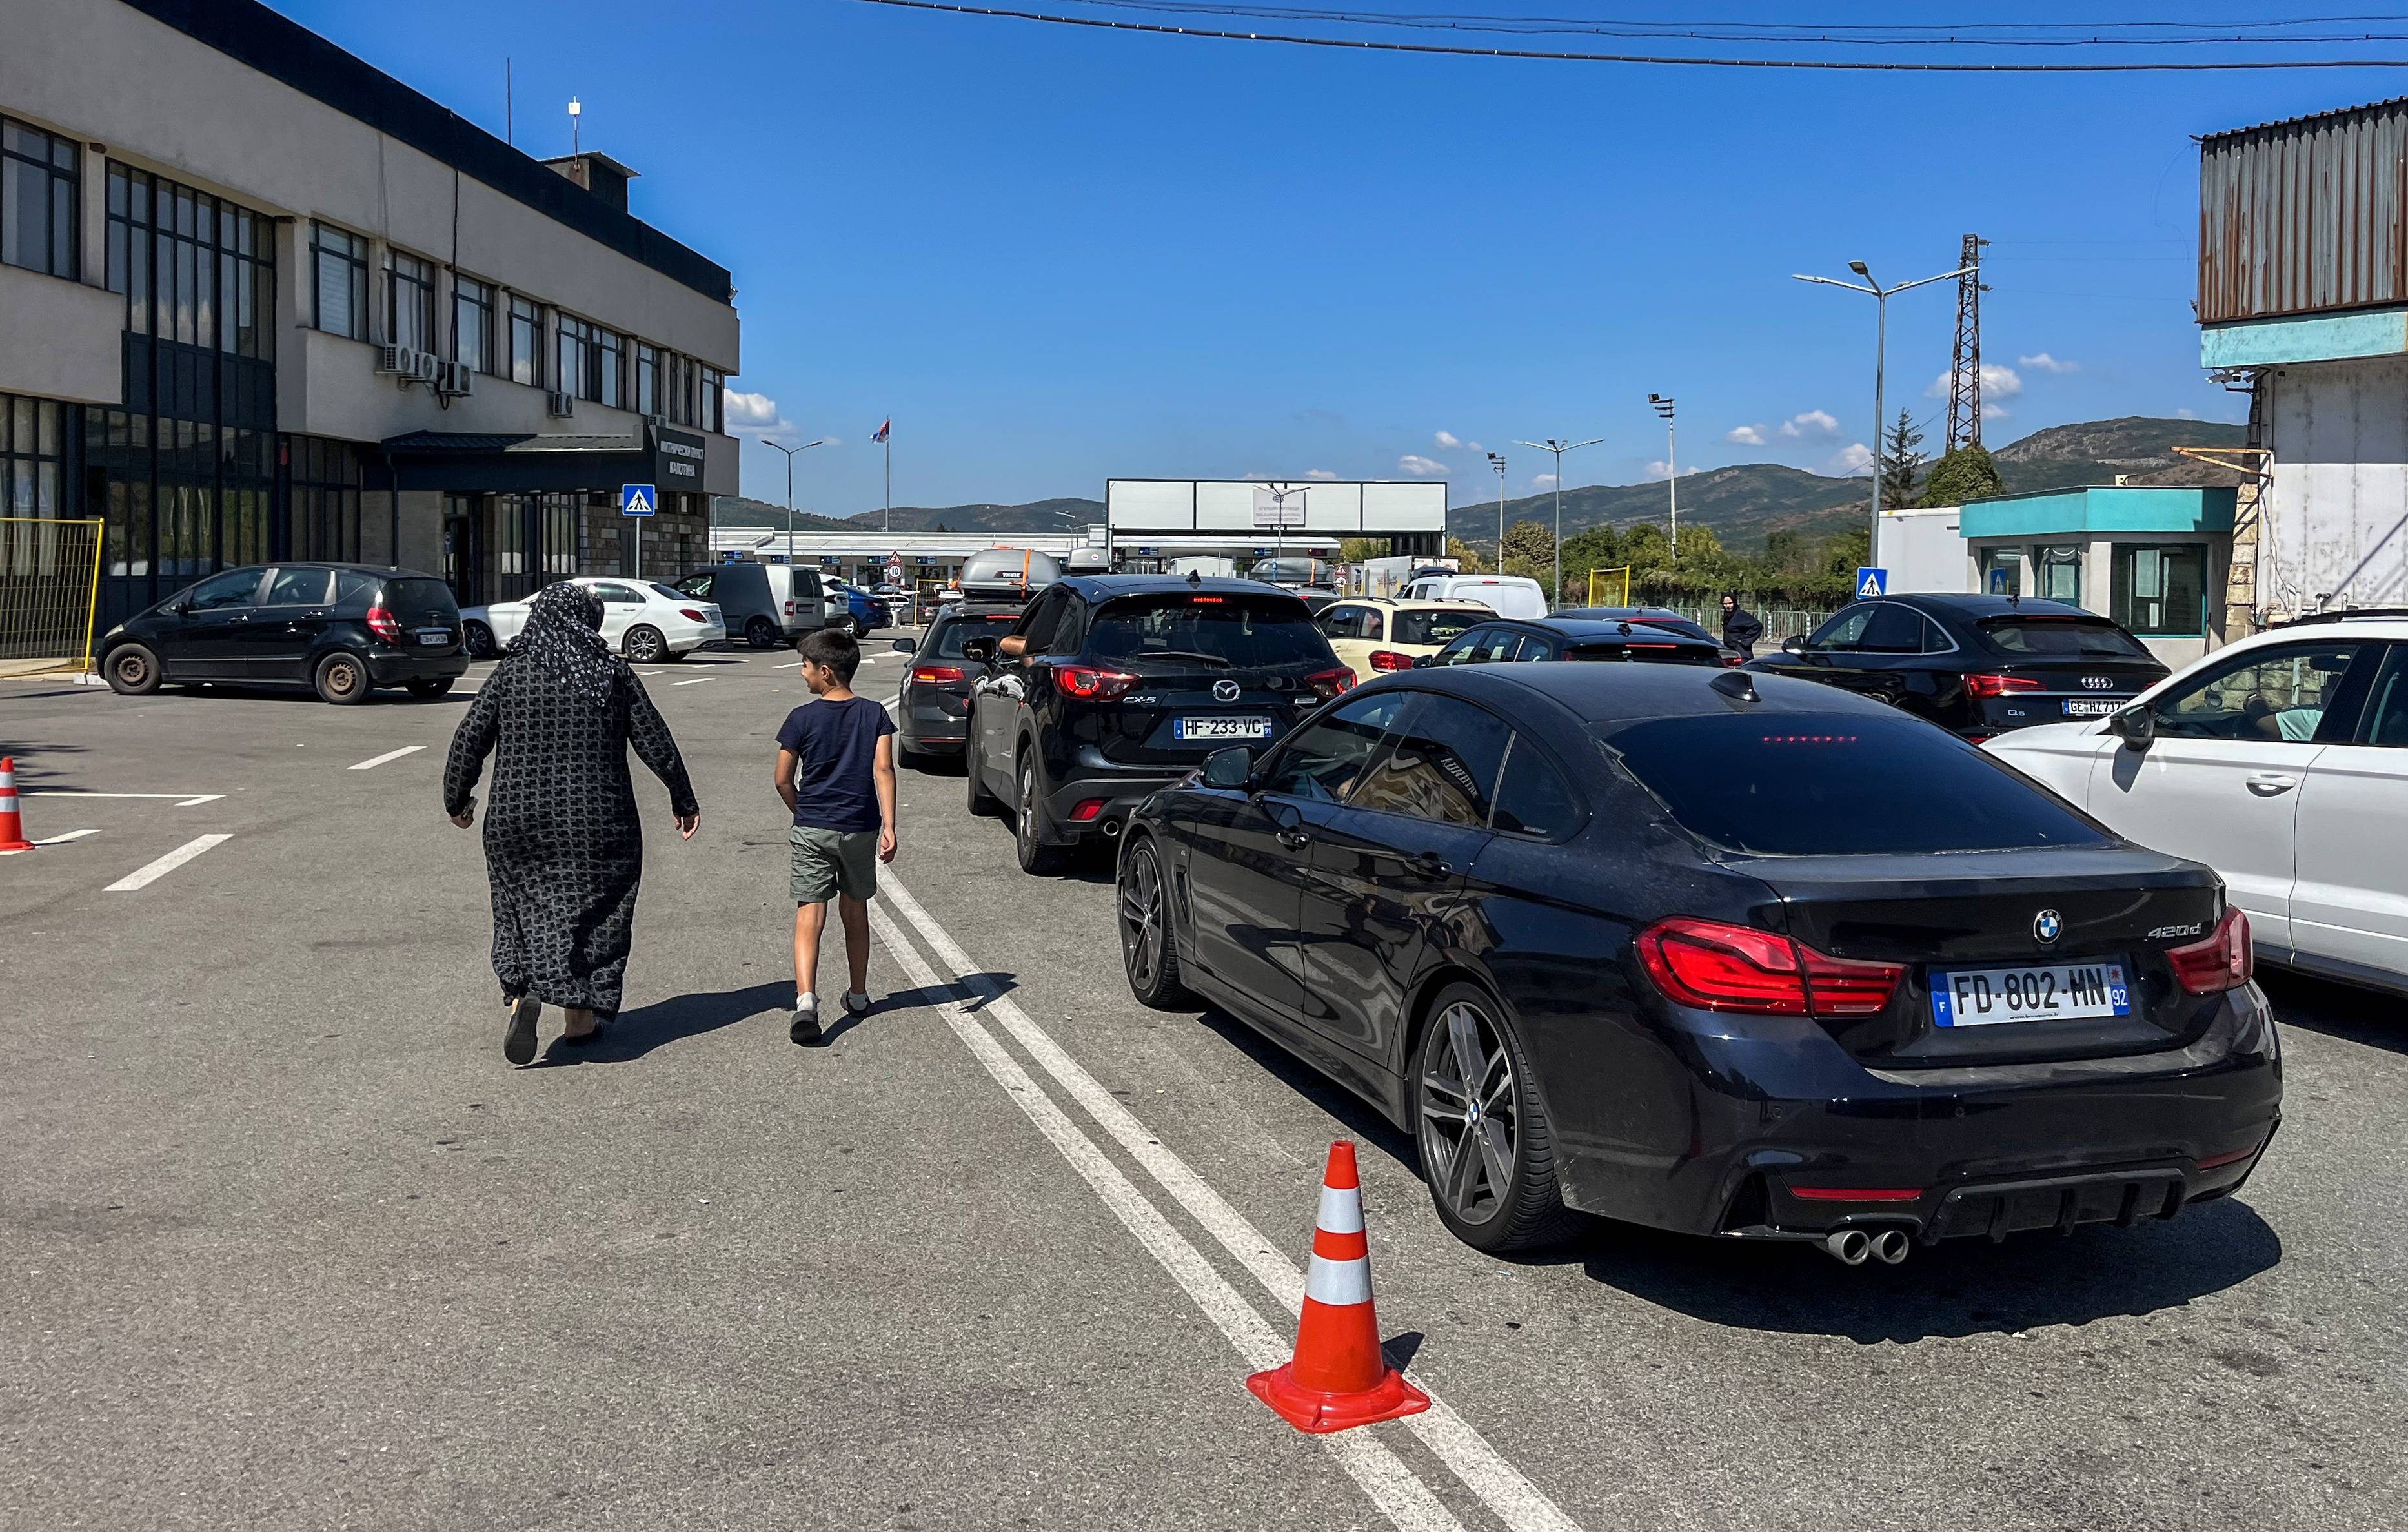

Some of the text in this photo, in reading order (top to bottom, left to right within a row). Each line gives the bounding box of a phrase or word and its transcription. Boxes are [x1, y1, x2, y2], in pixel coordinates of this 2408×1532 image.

[2070, 700, 2083, 712] GE
[1185, 719, 1261, 735] HF-233-VC
[2147, 923, 2201, 939] 420d
[1939, 968, 2128, 1015] F FD-802-MN 92
